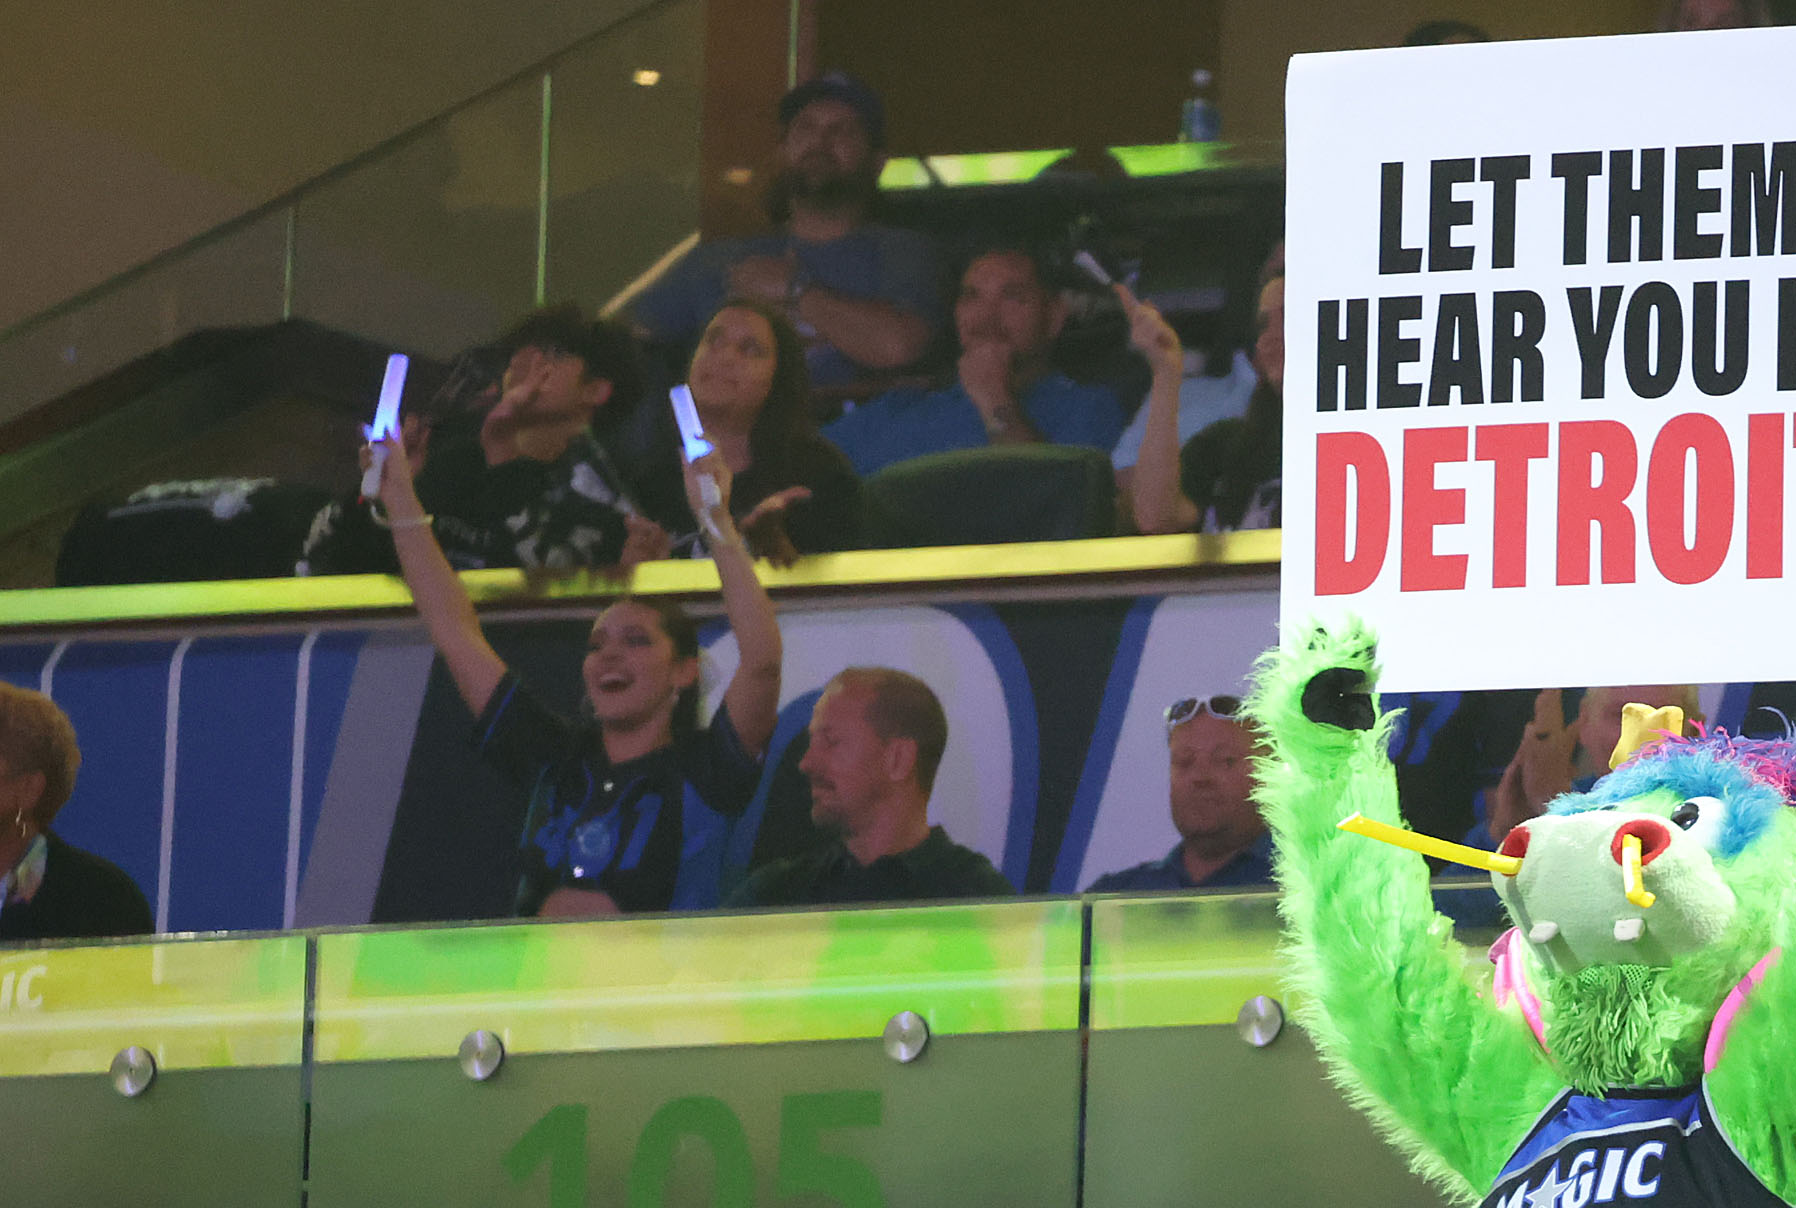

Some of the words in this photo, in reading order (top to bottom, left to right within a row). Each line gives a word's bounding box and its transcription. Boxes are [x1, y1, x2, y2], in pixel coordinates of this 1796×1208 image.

[1379, 154, 1531, 275] LET
[1316, 289, 1546, 413] HEAR
[1566, 280, 1750, 400] YOU
